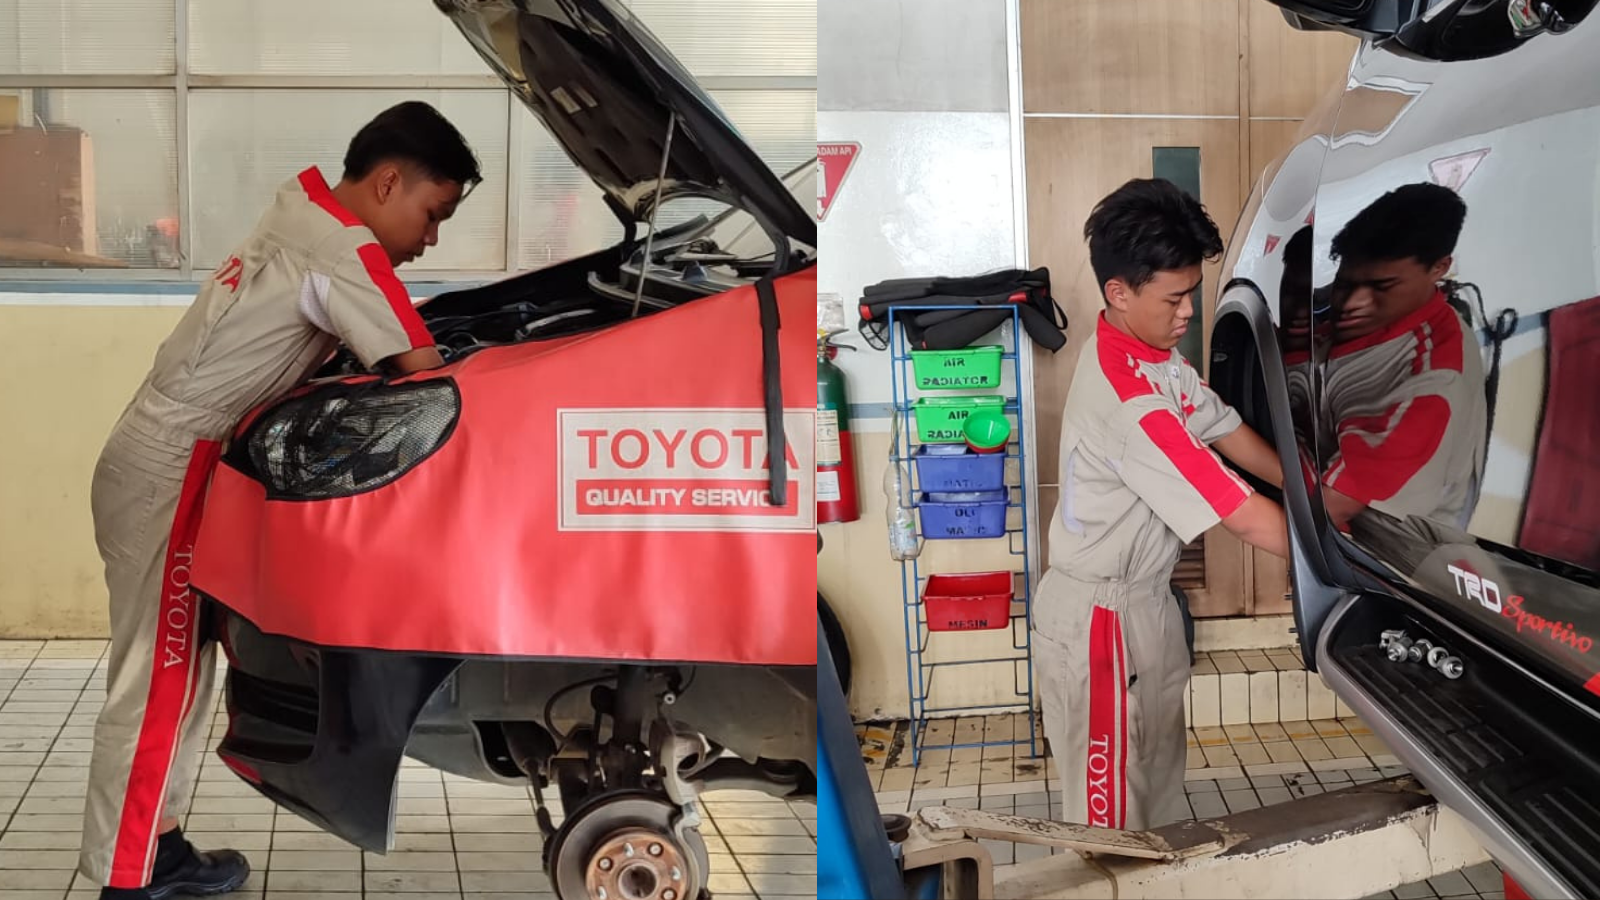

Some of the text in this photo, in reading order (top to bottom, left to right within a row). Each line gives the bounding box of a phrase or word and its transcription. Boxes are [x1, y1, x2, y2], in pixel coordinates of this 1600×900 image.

[840, 146, 852, 155] API
[943, 358, 965, 368] AIR
[922, 376, 988, 386] RADIATOR
[948, 411, 969, 420] AIR
[928, 430, 966, 439] RADIA
[577, 428, 799, 470] TOYOTA
[585, 488, 770, 507] QUALITY SERVIC
[163, 545, 193, 669] TOYOTA
[1447, 564, 1593, 654] TRD Sportivo
[1089, 734, 1109, 829] TOYOT
